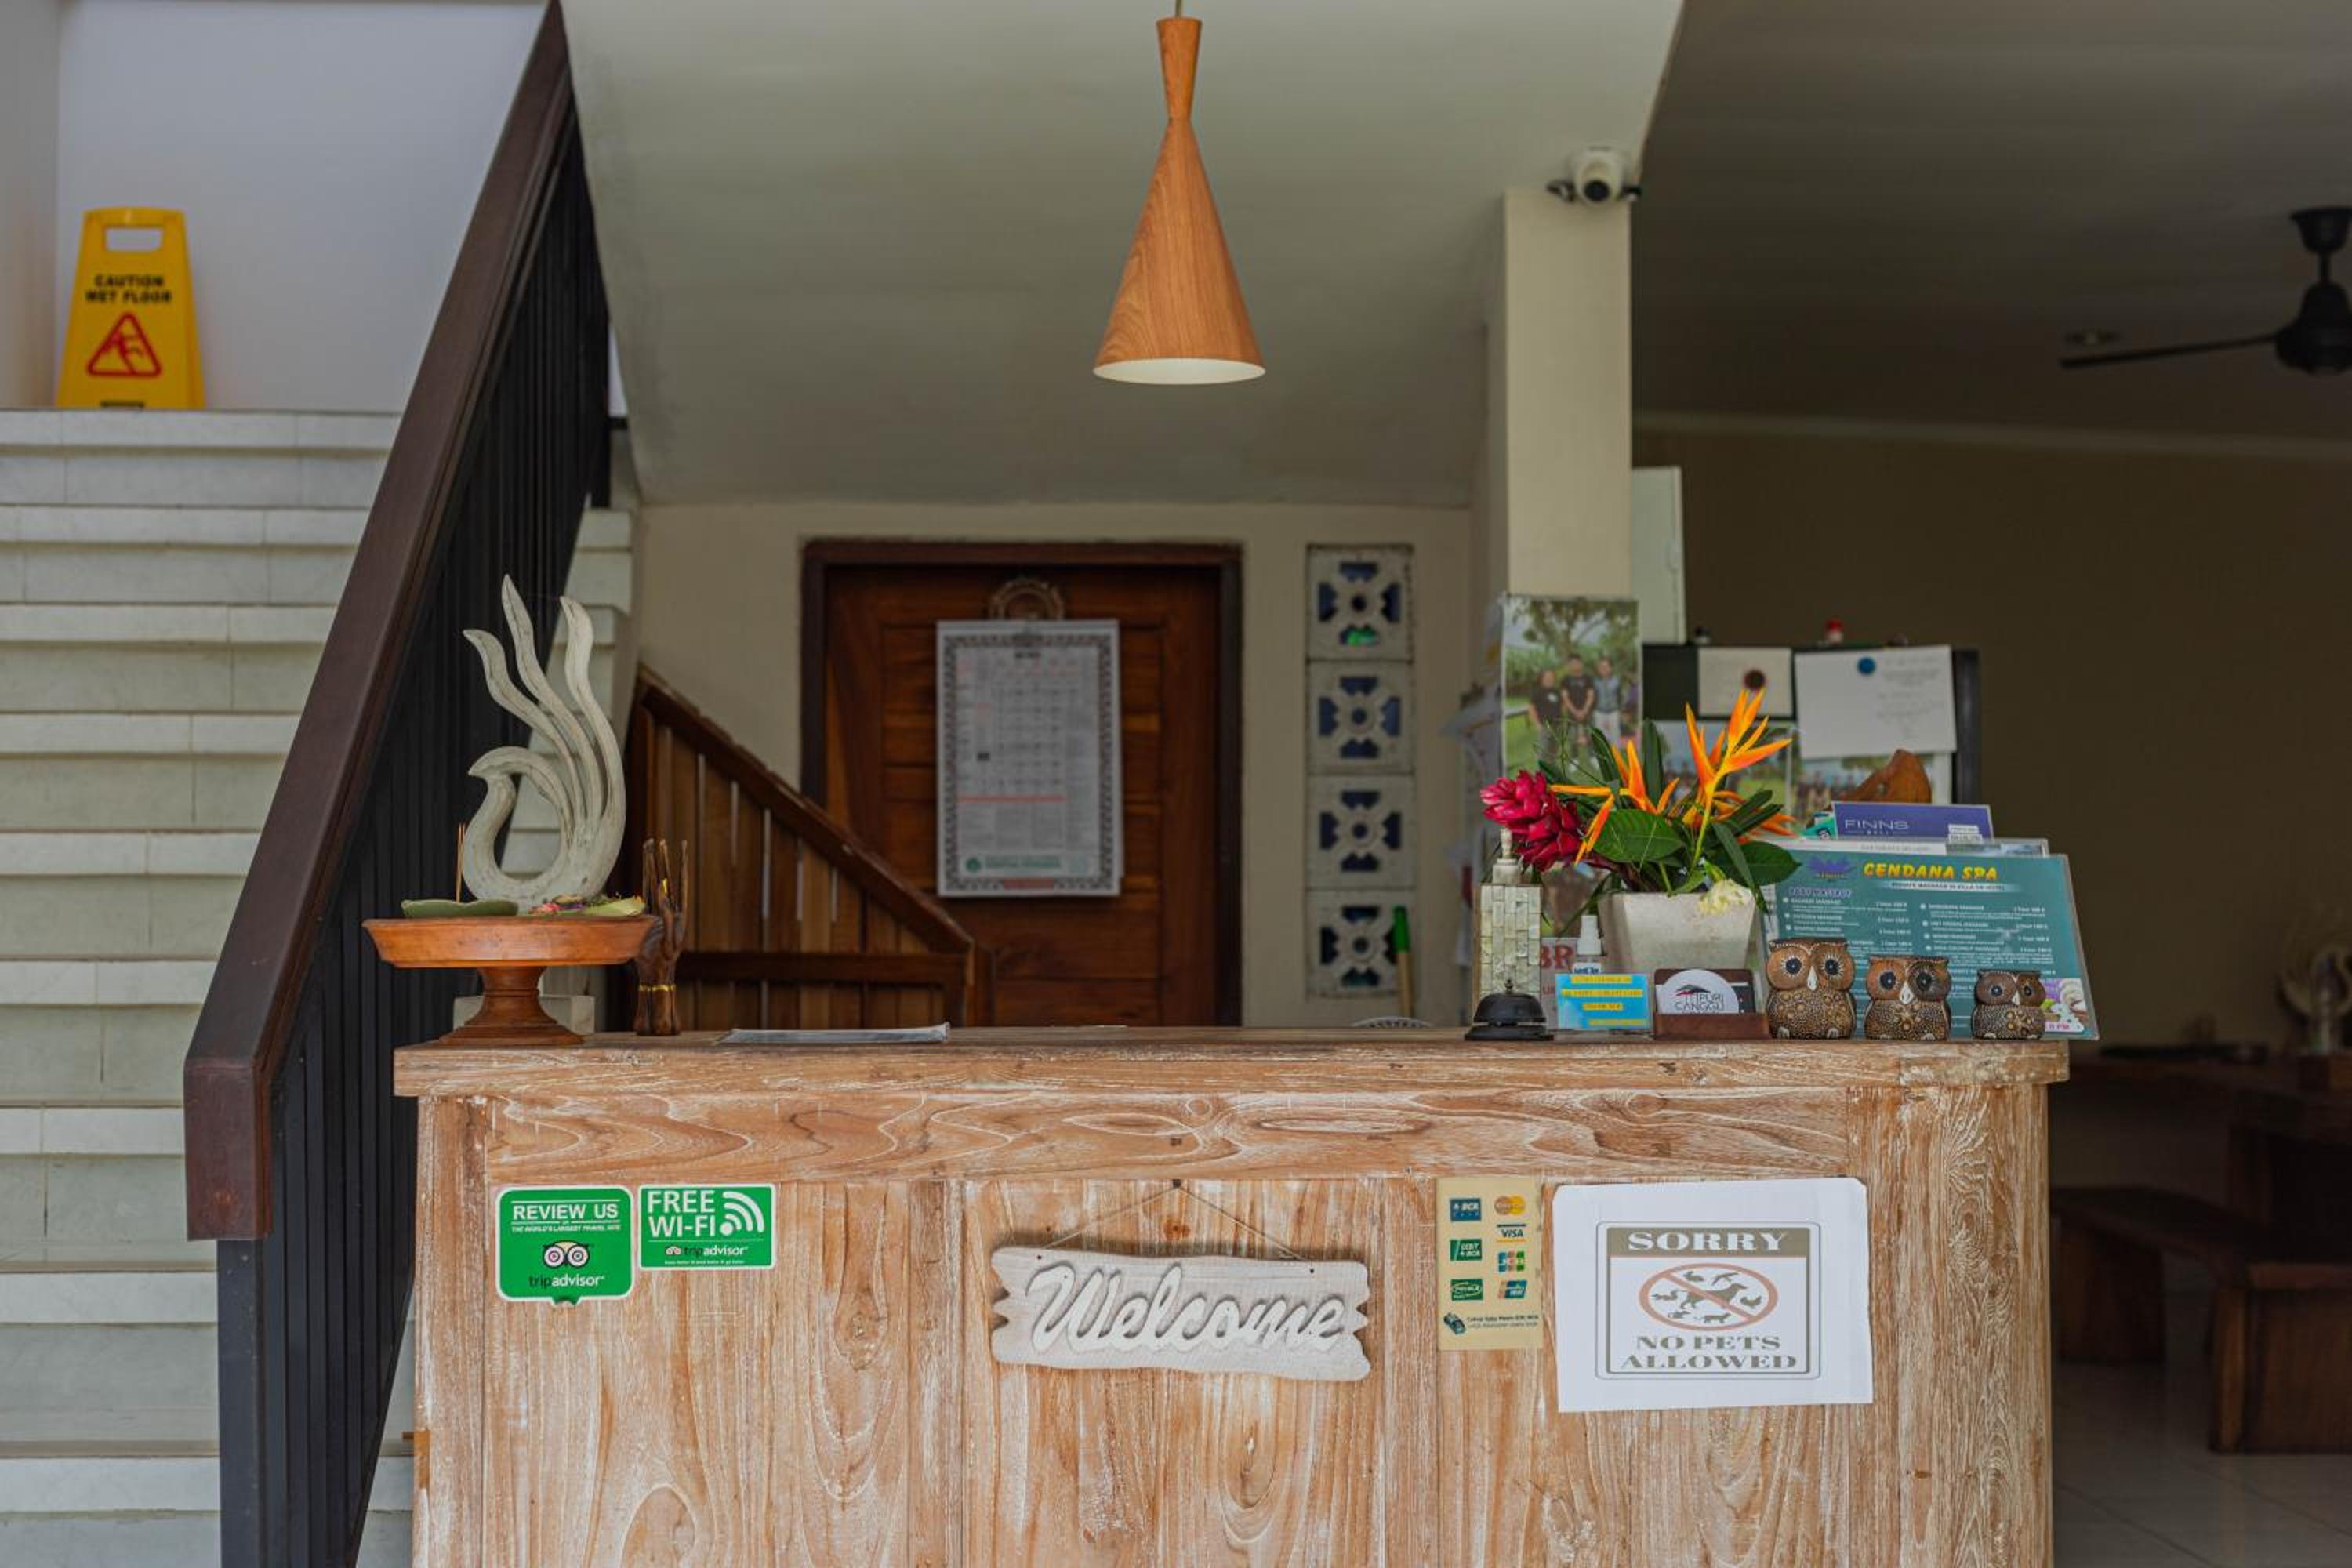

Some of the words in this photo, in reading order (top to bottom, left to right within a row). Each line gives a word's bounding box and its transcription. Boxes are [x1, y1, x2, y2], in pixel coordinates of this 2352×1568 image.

[94, 274, 165, 288] CAUTION
[85, 290, 117, 303] WET
[123, 290, 172, 304] FLOOR
[1845, 819, 1909, 830] FINNS
[1962, 866, 1998, 880] SPA
[647, 1189, 715, 1214] FREE
[514, 1204, 586, 1220] REVIEW
[594, 1203, 619, 1218] US
[648, 1215, 715, 1238] WI-FI
[1501, 1229, 1523, 1237] VISA
[1628, 1232, 1787, 1252] SORRY
[684, 1245, 745, 1257] tripadvisor
[529, 1274, 601, 1290] tripadvisor
[1025, 1260, 1345, 1354] Welcome
[1637, 1336, 1686, 1350] NO
[1693, 1335, 1781, 1349] PETS
[1620, 1354, 1798, 1370] ALLOWED
